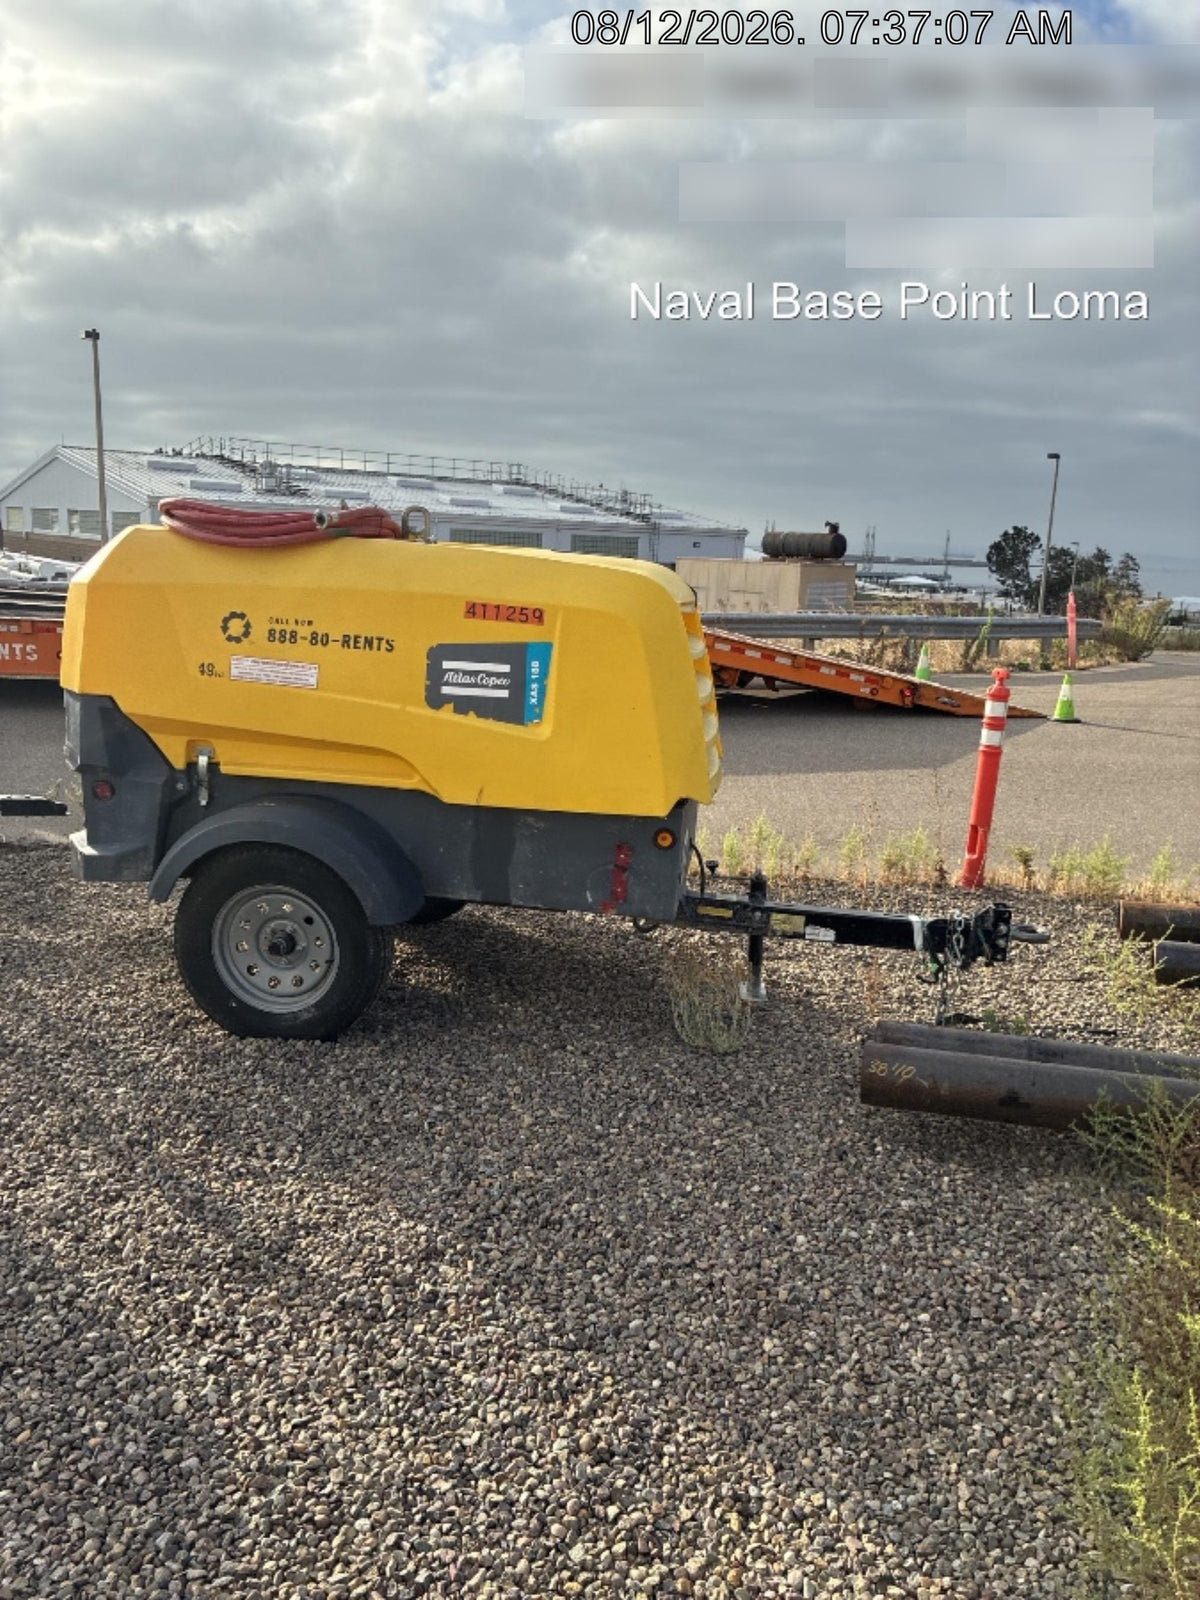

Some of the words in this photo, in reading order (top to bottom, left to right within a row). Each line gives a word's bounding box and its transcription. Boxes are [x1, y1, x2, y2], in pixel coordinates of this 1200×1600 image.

[466, 602, 543, 623] 411259
[267, 629, 395, 653] 888-80-RENTS
[443, 671, 475, 684] Atlas
[477, 672, 511, 687] Copco
